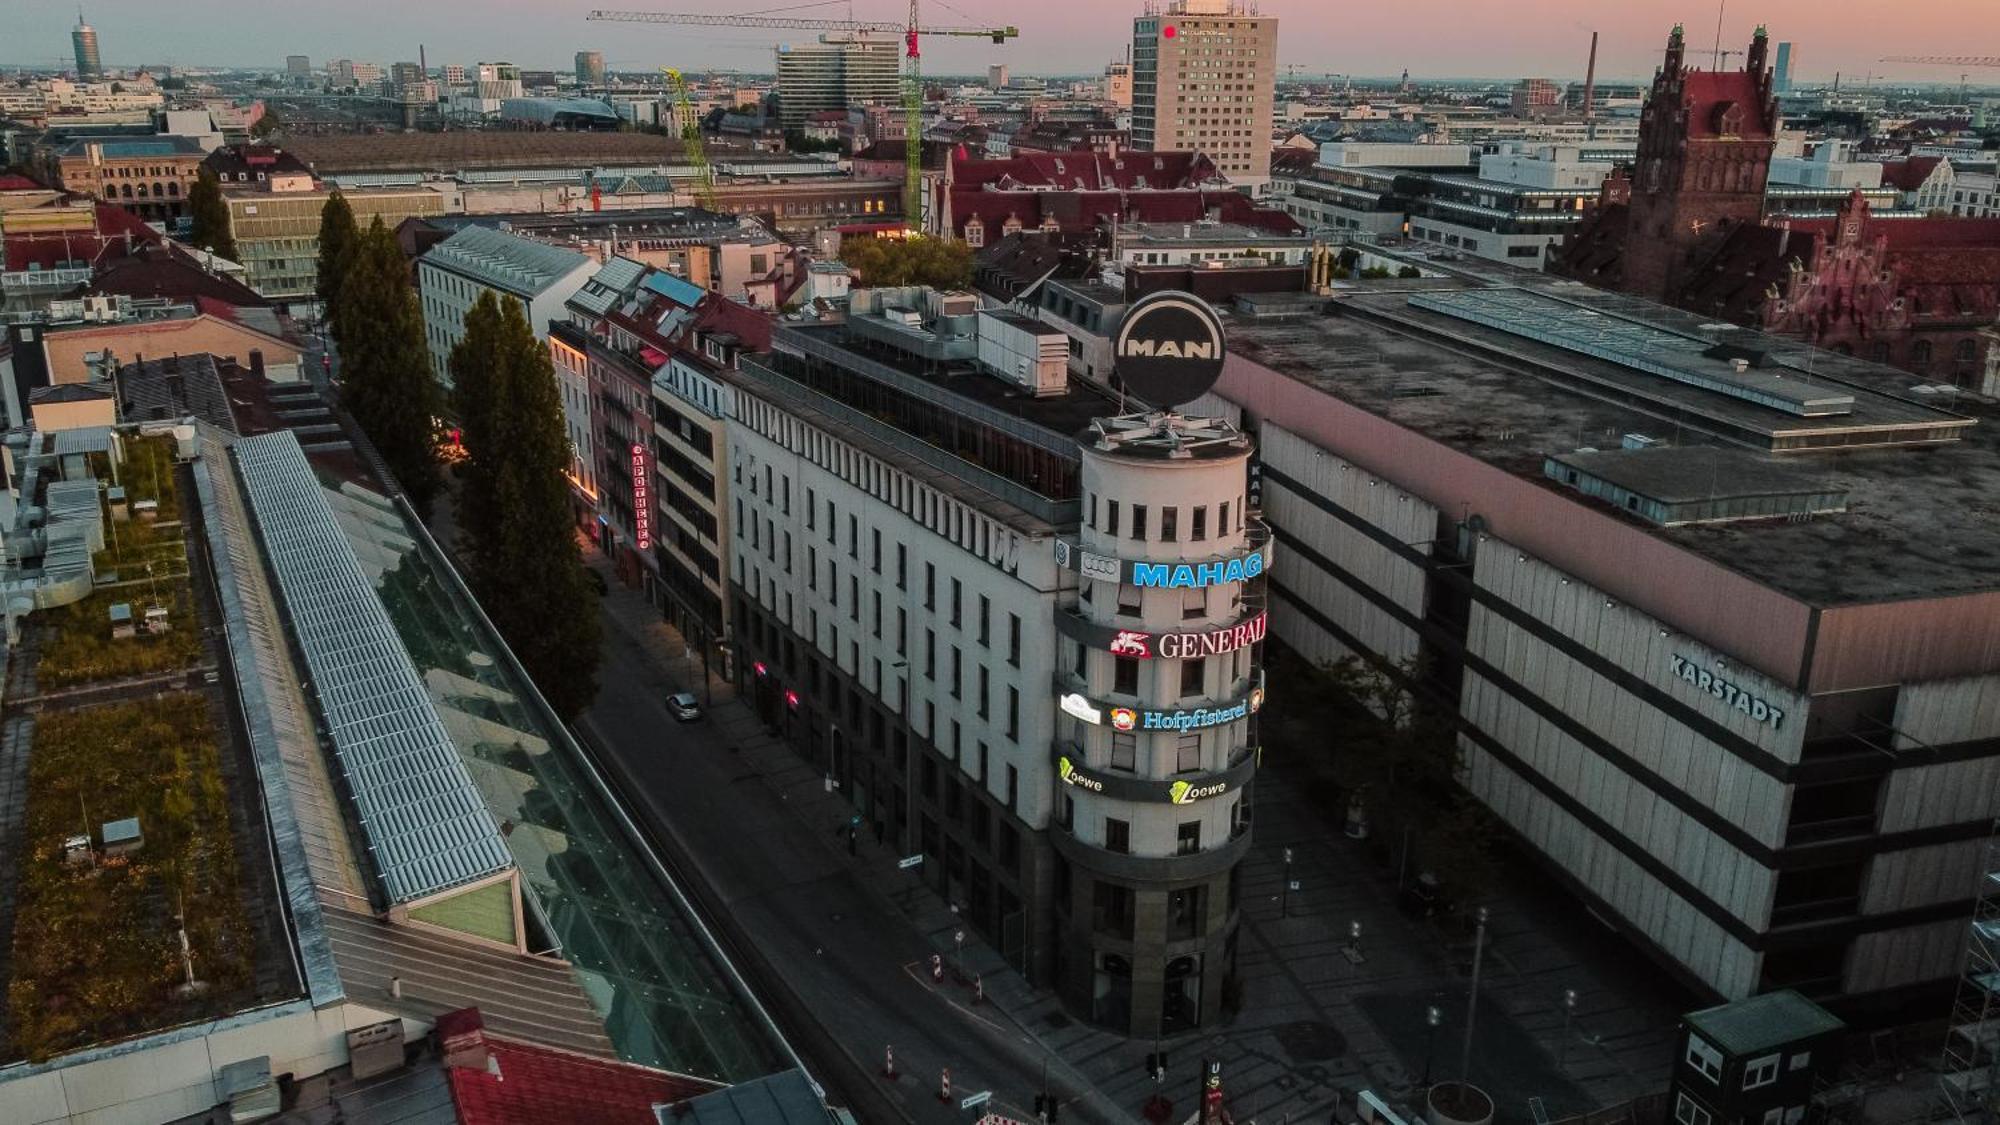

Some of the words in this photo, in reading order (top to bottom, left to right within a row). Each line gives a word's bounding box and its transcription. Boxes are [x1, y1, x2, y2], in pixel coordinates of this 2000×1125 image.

[1127, 339, 1211, 358] MAN
[633, 455, 648, 539] APOTHEKE
[1133, 552, 1263, 588] MAHAG
[1670, 654, 1784, 729] KARSTADT
[1144, 699, 1247, 733] Hofpfisterei
[1063, 765, 1103, 792] Loewe
[1181, 781, 1226, 804] Loewe
